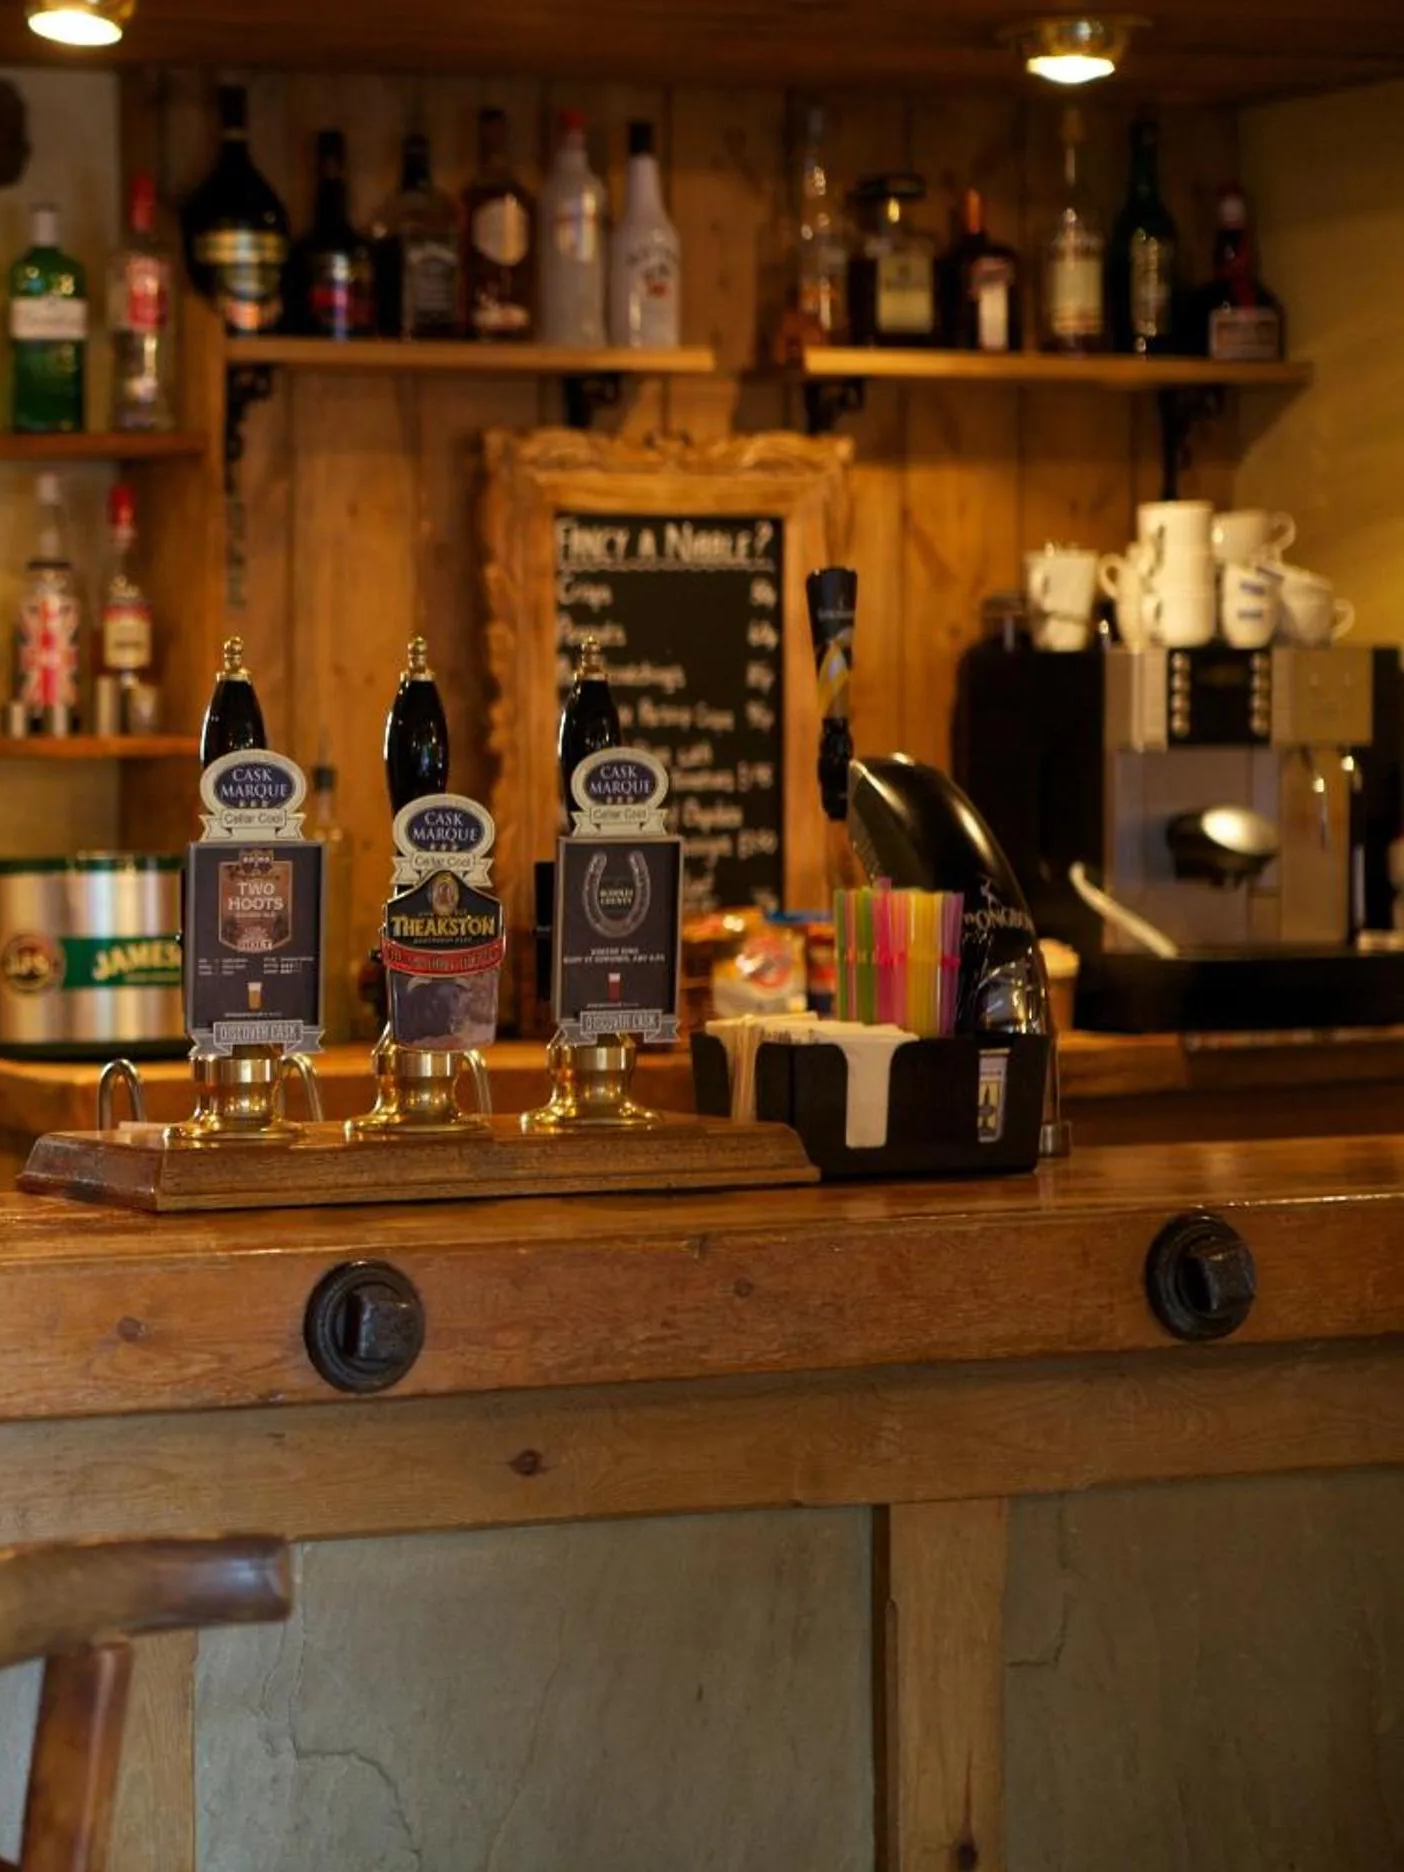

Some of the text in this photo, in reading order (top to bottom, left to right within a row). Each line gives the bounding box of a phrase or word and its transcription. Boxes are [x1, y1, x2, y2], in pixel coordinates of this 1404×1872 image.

[232, 767, 272, 781] CASK
[600, 765, 638, 780] CASK
[221, 783, 288, 799] MARQUE
[590, 780, 650, 795] MARQUE
[424, 811, 464, 826] CASK
[412, 827, 478, 843] MARQUE
[237, 882, 275, 896] TWO
[227, 897, 284, 912] HOOTS
[390, 914, 495, 937] THEAKSTON
